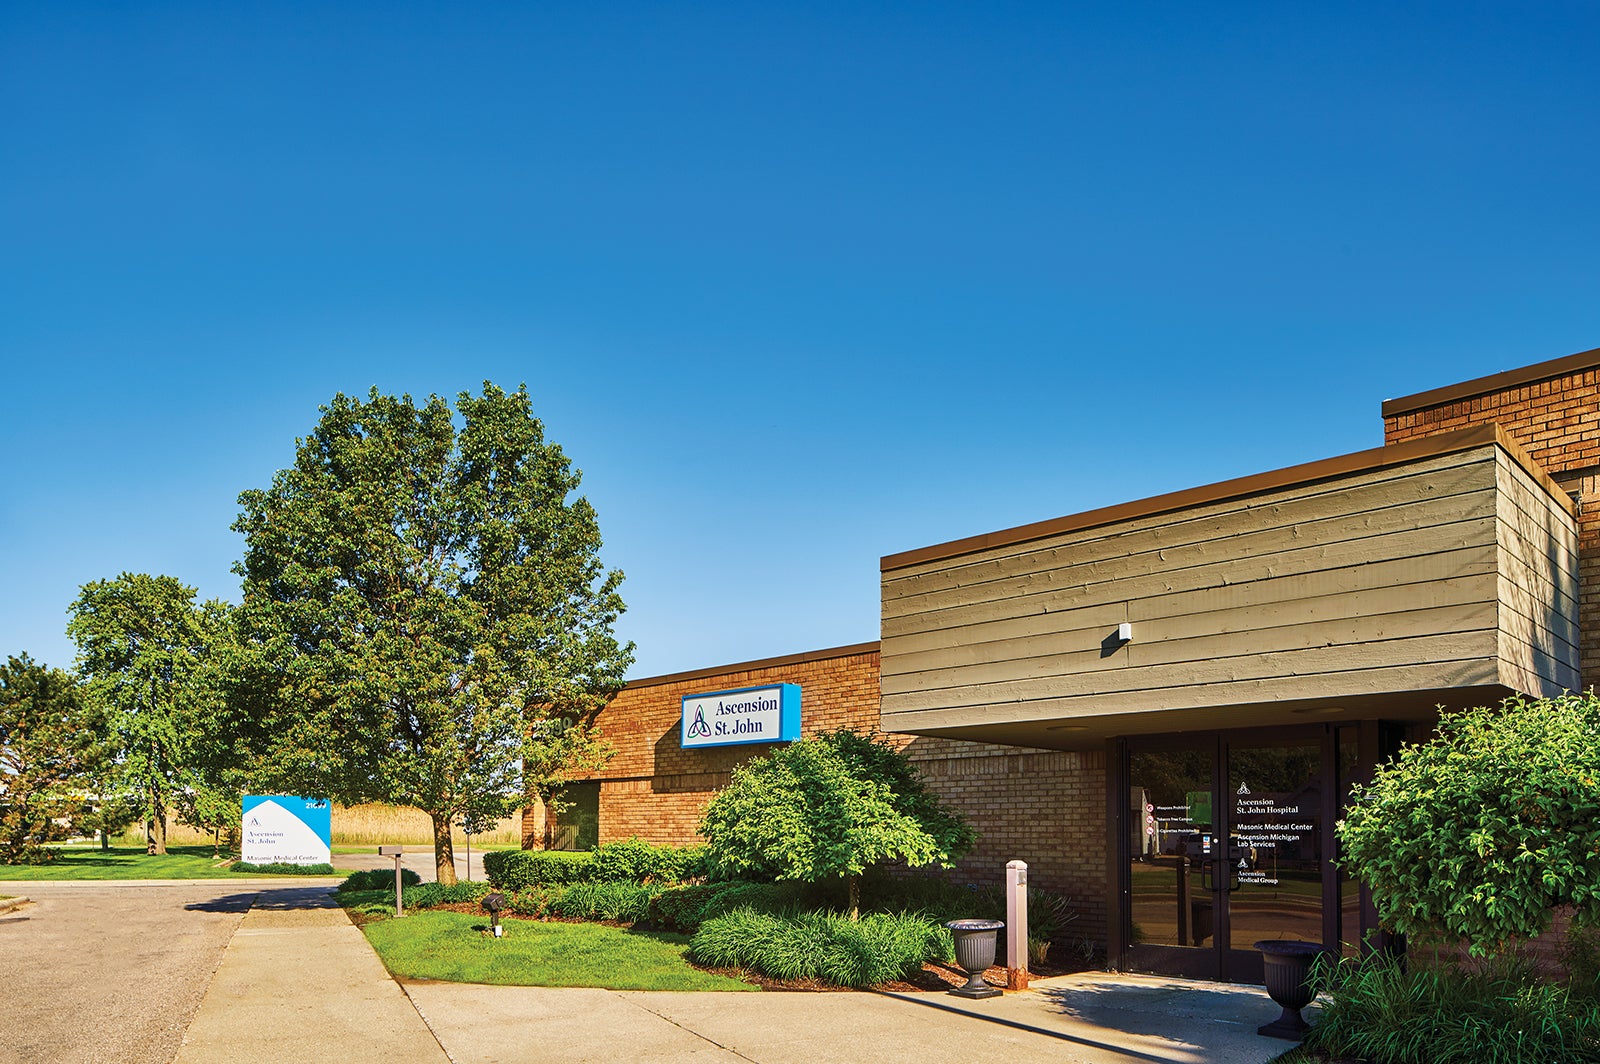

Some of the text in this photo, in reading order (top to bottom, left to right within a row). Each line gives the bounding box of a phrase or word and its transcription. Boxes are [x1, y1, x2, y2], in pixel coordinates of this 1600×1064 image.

[716, 696, 778, 716] Ascension
[715, 718, 763, 736] St. John
[1236, 798, 1274, 806] Ascension
[1236, 805, 1299, 815] St. John Hospital
[1237, 833, 1300, 842] Ascension Michigan
[1249, 840, 1276, 848] Services
[1260, 877, 1279, 885] Group
